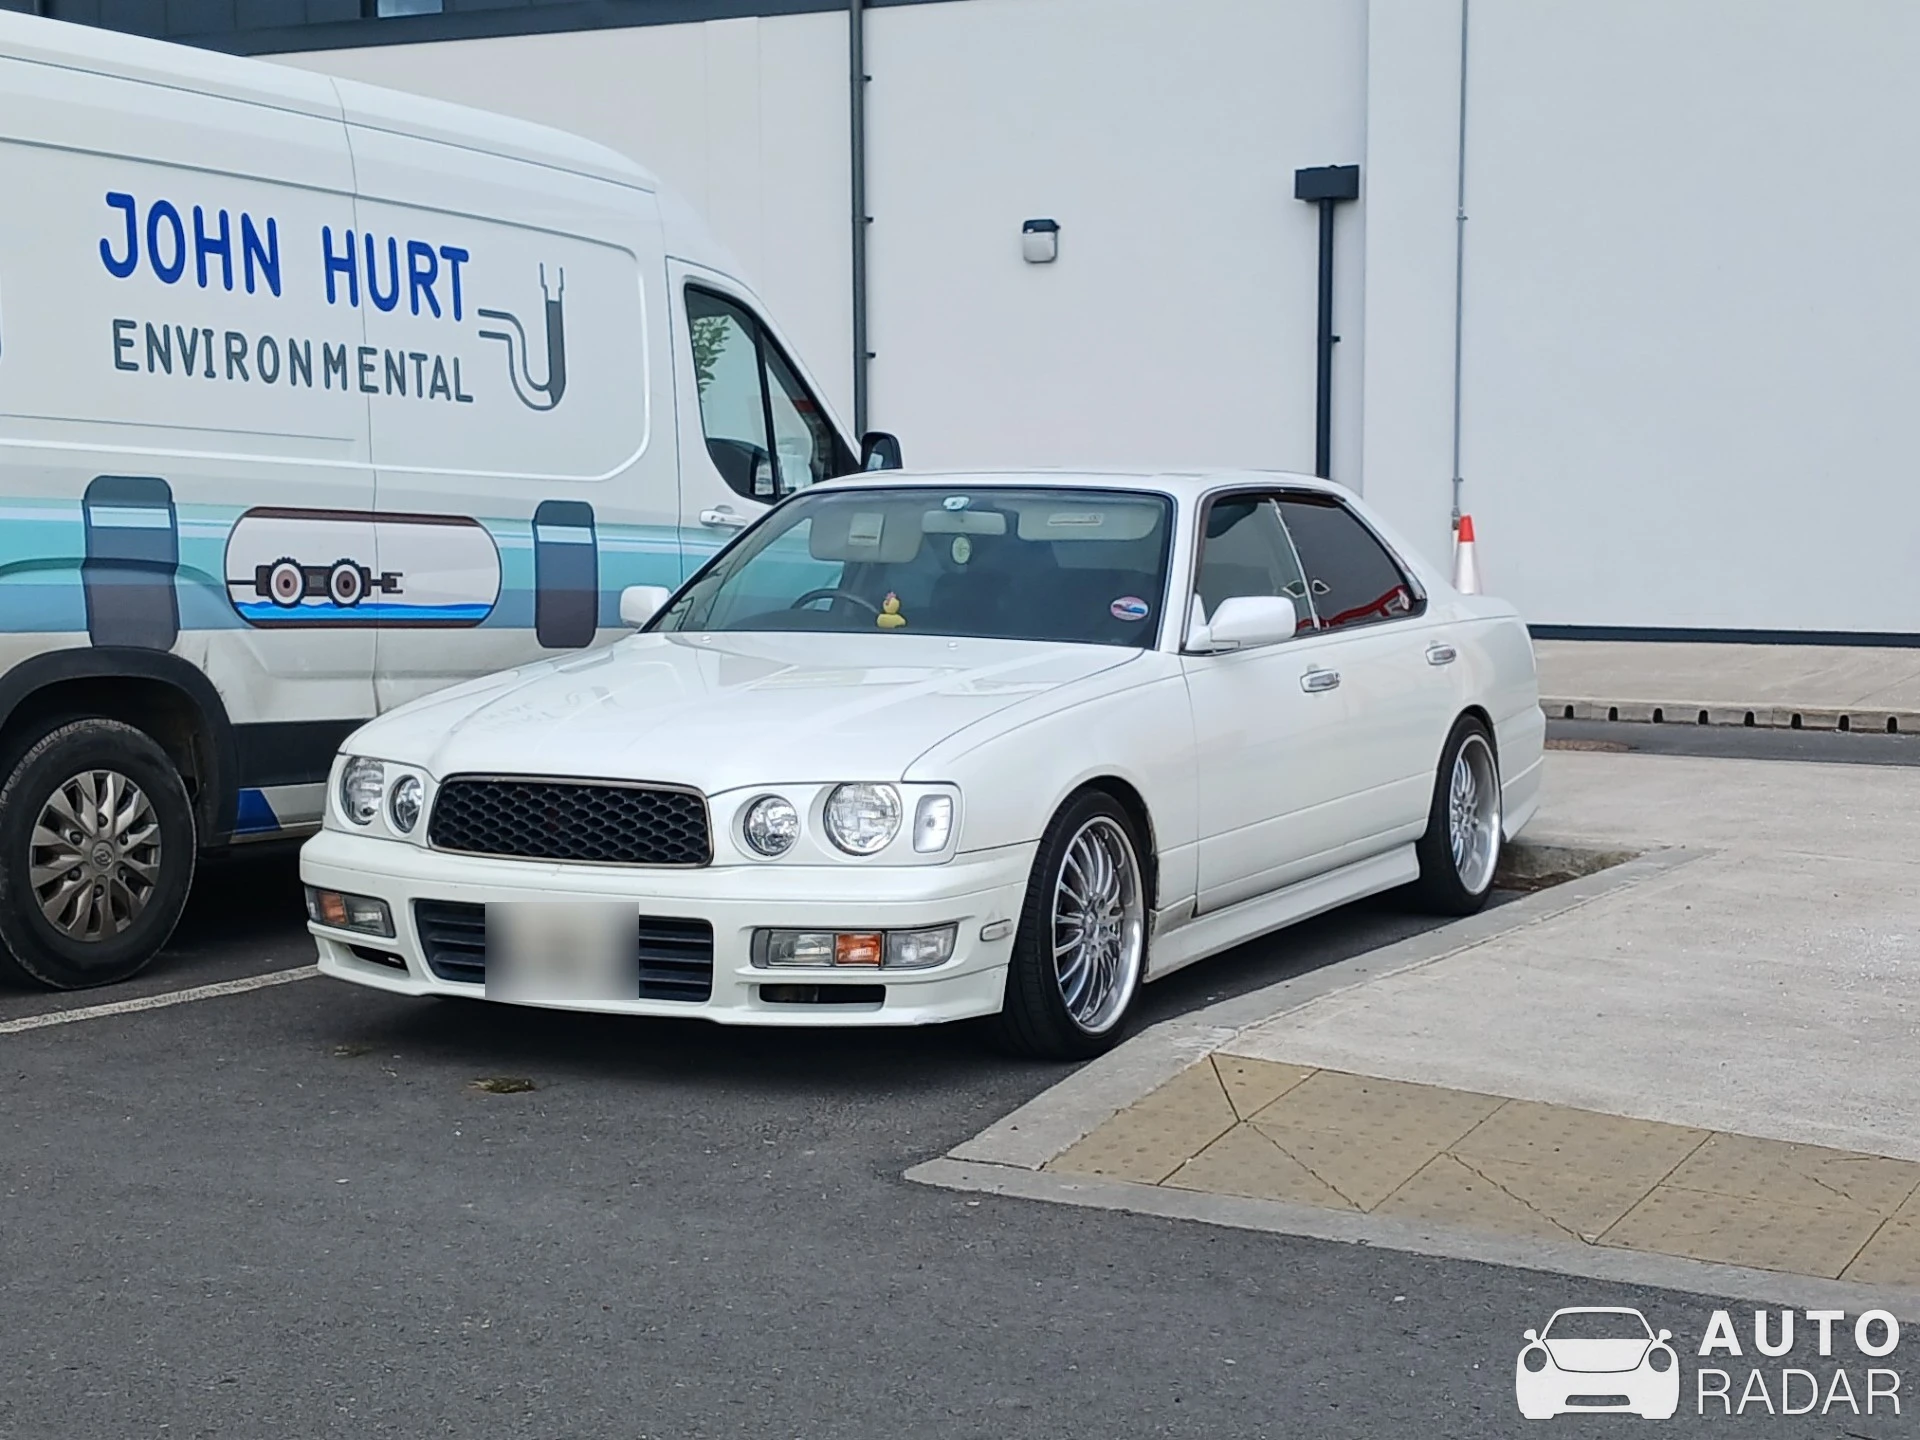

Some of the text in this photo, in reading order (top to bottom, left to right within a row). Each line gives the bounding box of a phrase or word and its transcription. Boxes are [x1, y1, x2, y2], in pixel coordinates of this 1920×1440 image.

[100, 191, 470, 322] JOHN HURT
[112, 318, 474, 403] ENVIRONMENTAL
